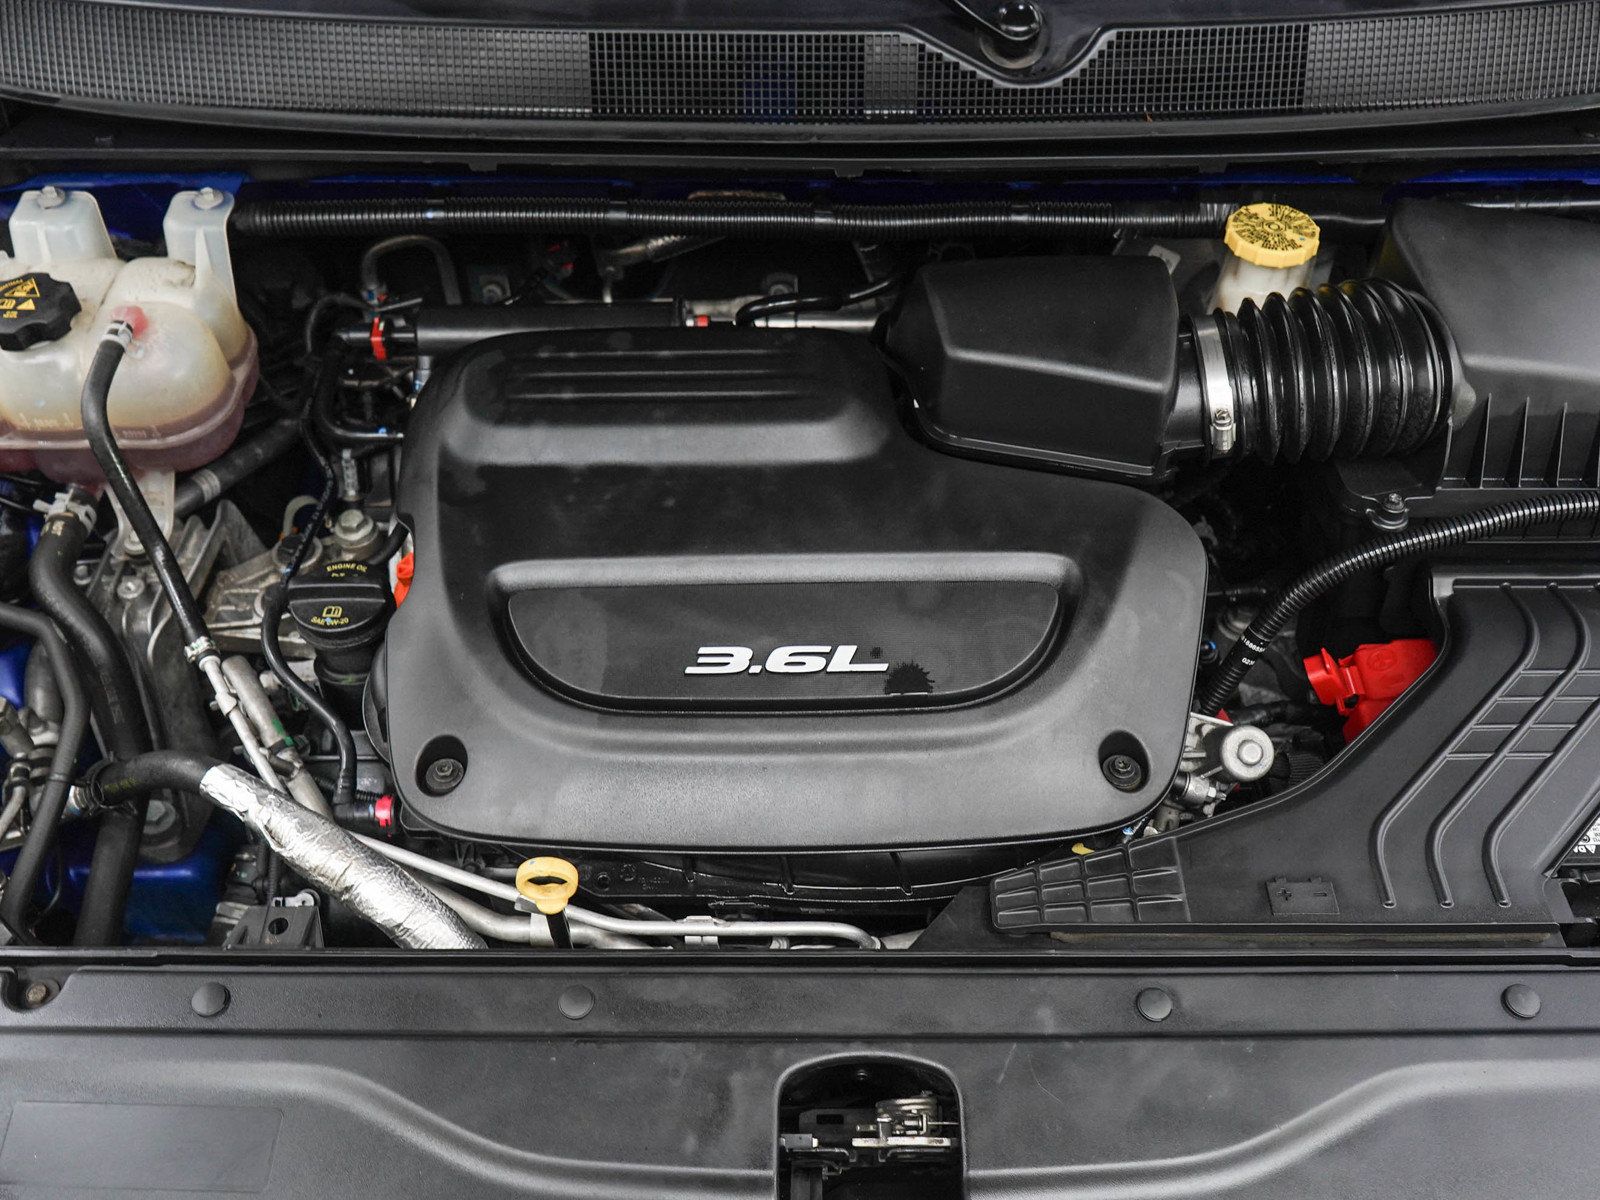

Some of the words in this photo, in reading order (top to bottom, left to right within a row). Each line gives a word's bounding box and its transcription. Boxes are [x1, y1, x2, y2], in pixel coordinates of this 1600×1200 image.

[326, 563, 357, 572] ENGINE
[357, 564, 368, 572] OIL
[311, 616, 324, 625] SAE
[684, 643, 890, 674] 3.6L
